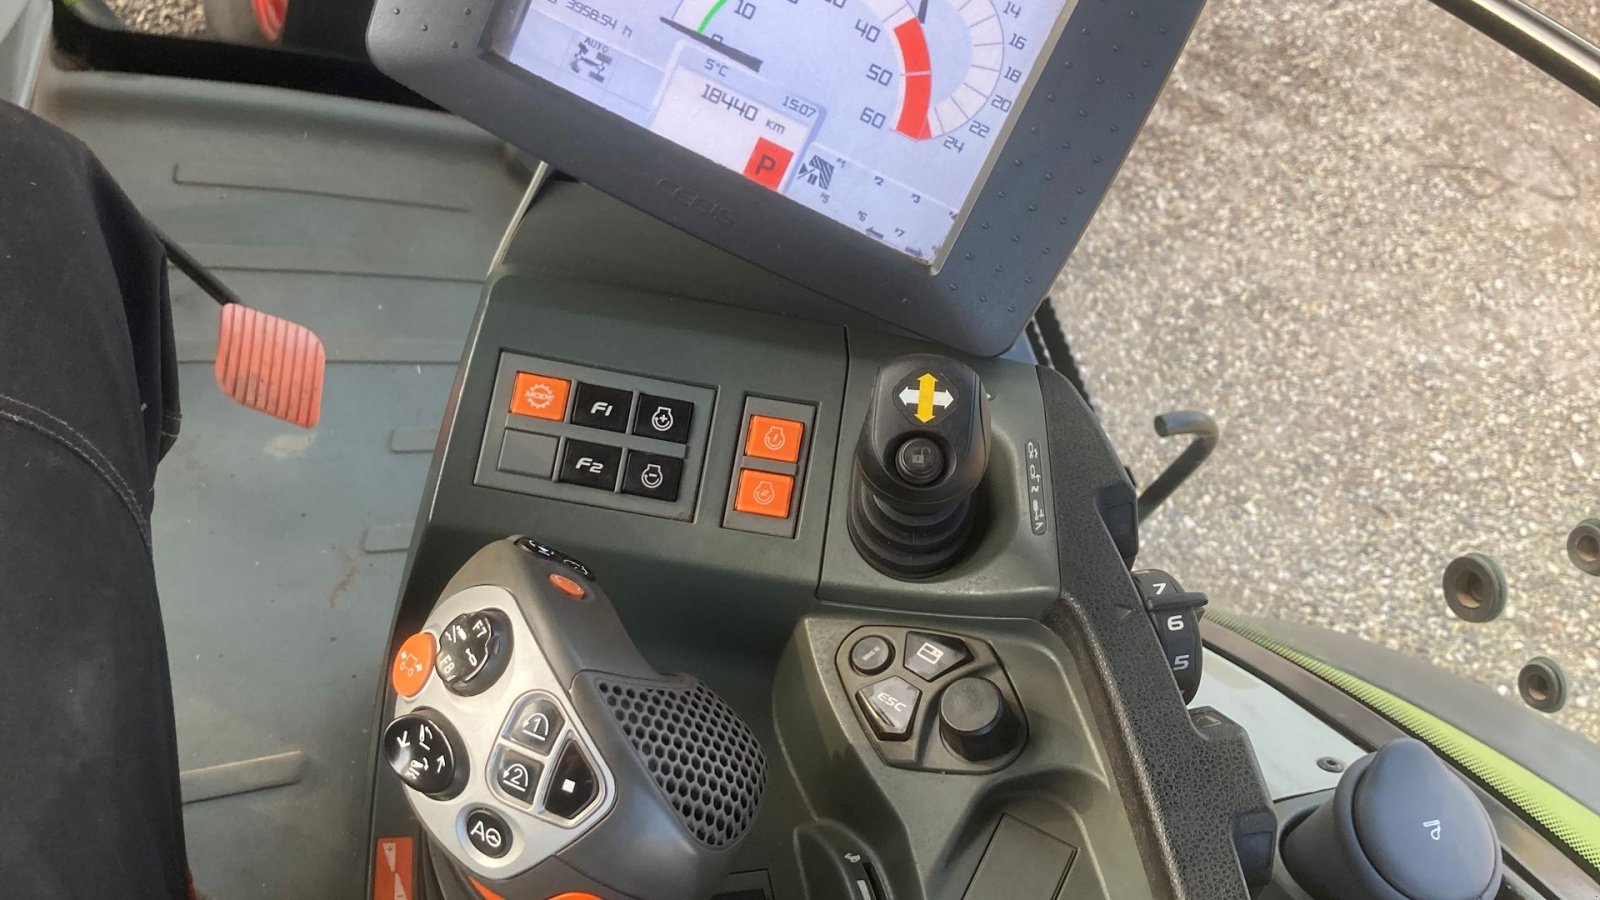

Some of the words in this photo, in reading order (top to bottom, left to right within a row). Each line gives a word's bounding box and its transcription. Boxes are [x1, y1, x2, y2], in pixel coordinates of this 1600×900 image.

[733, 0, 757, 20] 10
[1002, 1, 1022, 19] 14
[854, 18, 881, 43] 40
[583, 36, 609, 53] AUTO
[1008, 33, 1027, 51] 16
[865, 63, 893, 87] 50
[1003, 66, 1022, 84] 18
[700, 84, 759, 123] 18440
[991, 94, 1012, 113] 20
[859, 107, 886, 129] 60
[968, 120, 990, 139] 22
[943, 136, 965, 154] 24
[754, 153, 777, 176] P
[590, 401, 613, 417] F1
[575, 457, 604, 474] F2
[1152, 582, 1167, 596] 7
[472, 619, 488, 639] F7
[1167, 614, 1185, 632] 6
[439, 653, 456, 675] F8
[1172, 654, 1190, 672] 5
[876, 691, 907, 712] ESC
